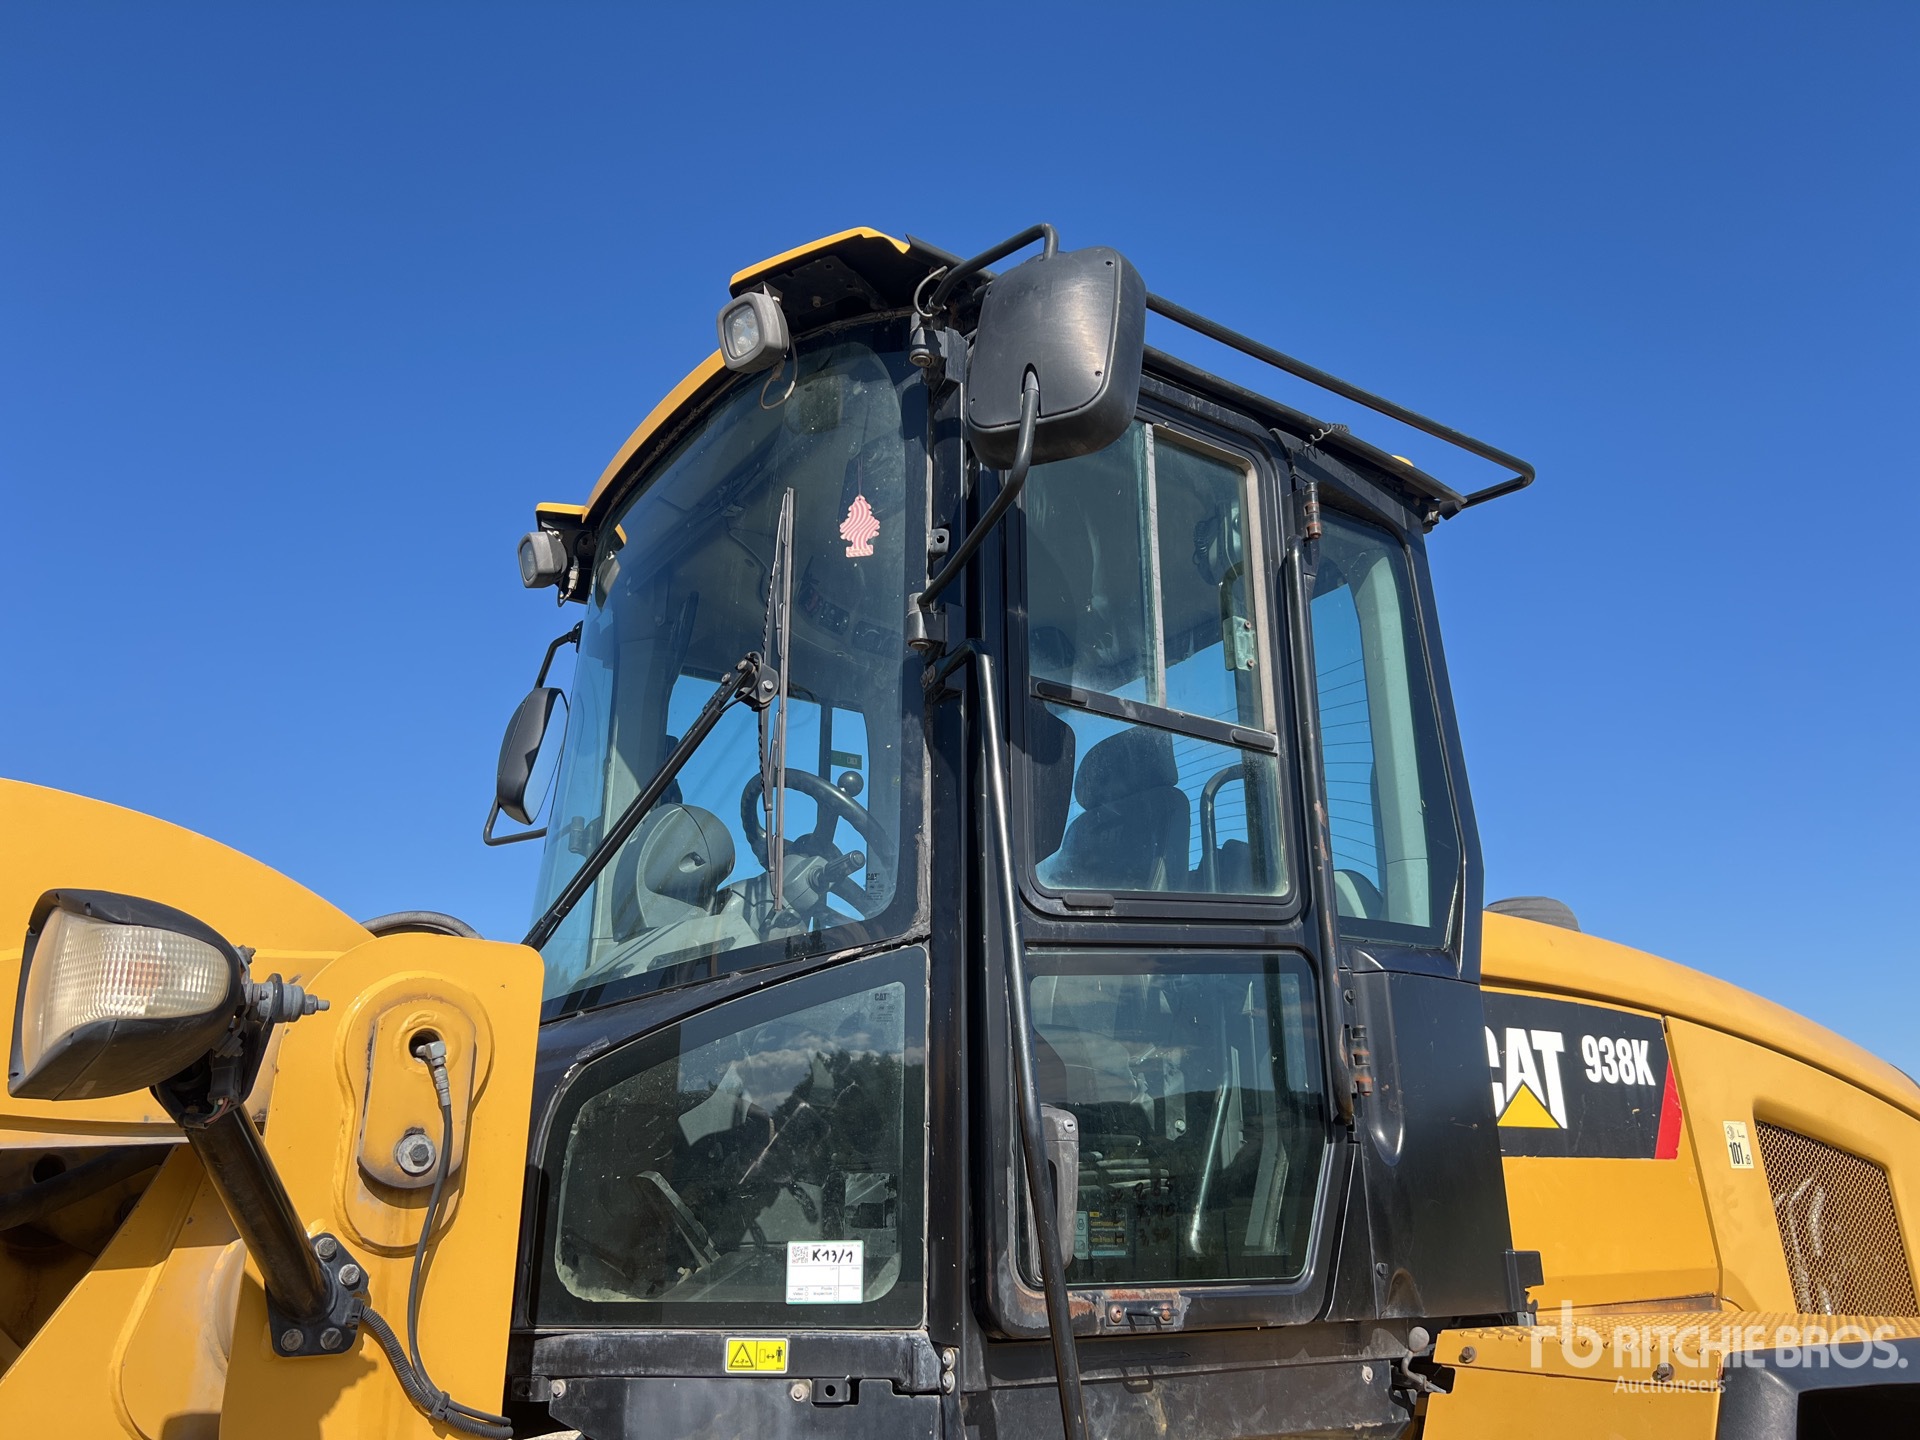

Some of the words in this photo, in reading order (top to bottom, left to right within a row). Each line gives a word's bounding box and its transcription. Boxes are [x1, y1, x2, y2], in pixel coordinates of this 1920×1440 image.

[1581, 1034, 1656, 1087] 938K
[1729, 1141, 1745, 1165] 101
[812, 1248, 853, 1264] K13/1
